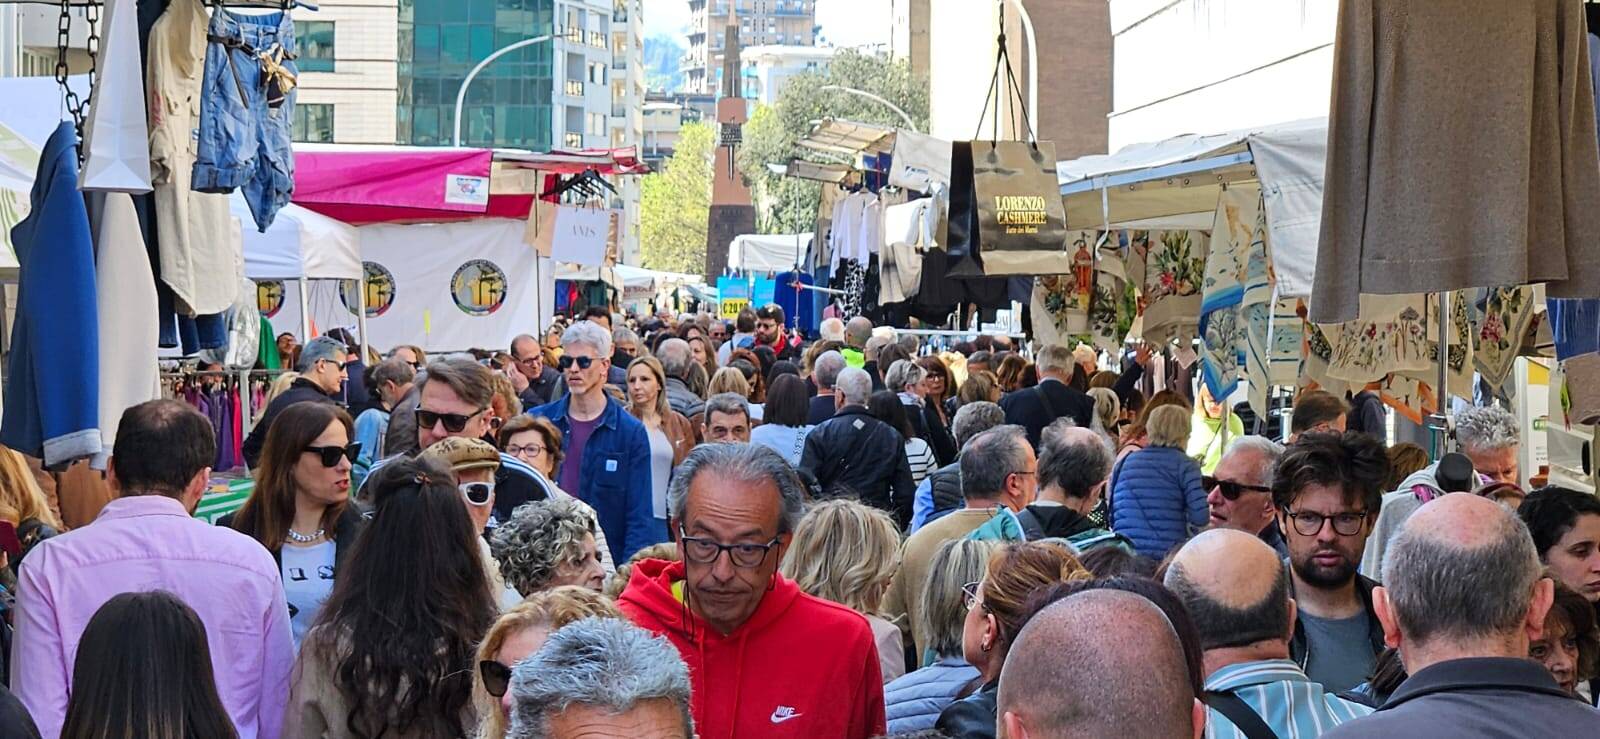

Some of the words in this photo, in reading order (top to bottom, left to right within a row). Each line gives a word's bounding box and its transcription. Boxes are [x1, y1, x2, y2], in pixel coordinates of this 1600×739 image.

[995, 195, 1046, 211] LORENZO
[996, 211, 1047, 225] CASHMERE
[775, 705, 795, 717] NIKE
